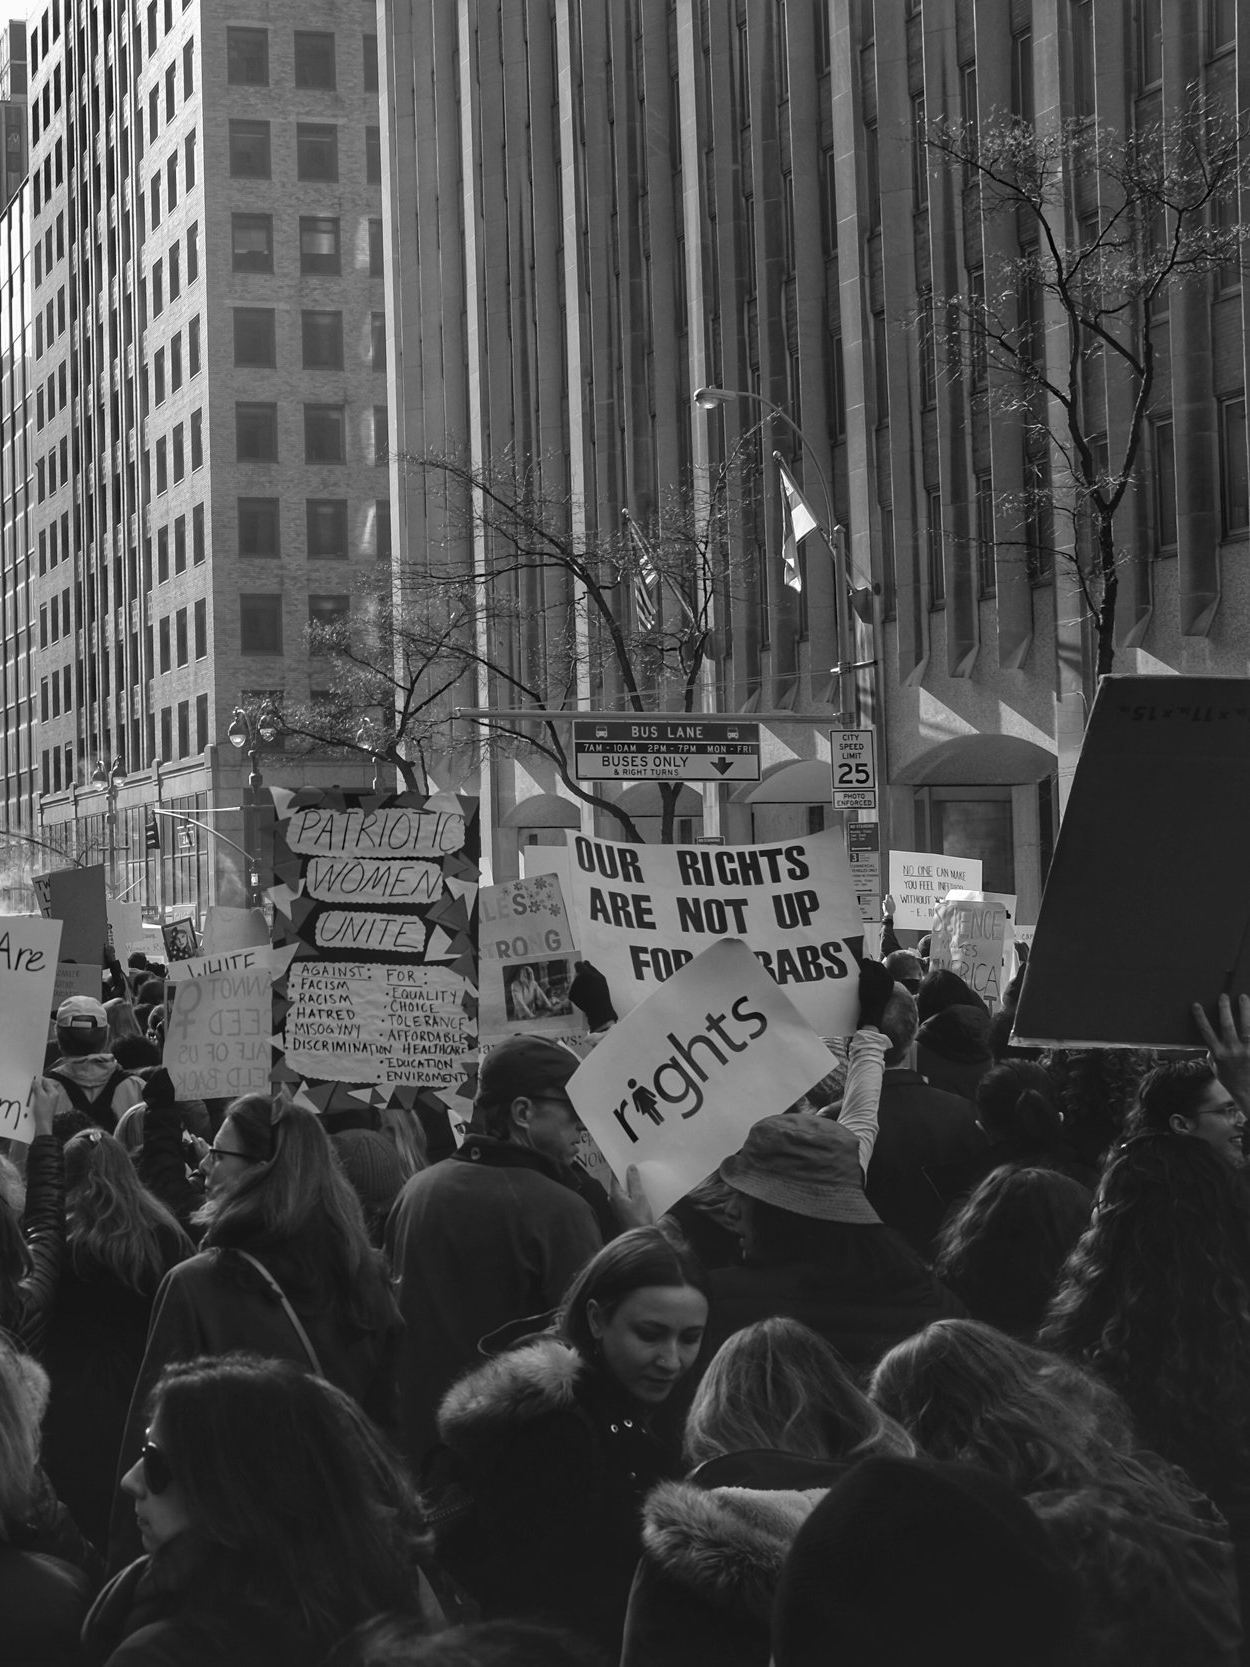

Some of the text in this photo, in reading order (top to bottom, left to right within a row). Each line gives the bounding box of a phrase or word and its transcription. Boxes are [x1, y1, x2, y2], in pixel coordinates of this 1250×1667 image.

[631, 726, 703, 738] BUS LANE
[583, 743, 602, 752] 7AM
[613, 744, 637, 752] 10AM
[647, 744, 667, 753] 2PM
[678, 745, 697, 753] 7PM
[707, 745, 725, 753] MON
[737, 745, 752, 753] FRI
[839, 743, 865, 751] SPEED
[601, 756, 689, 768] BUSES ONLY
[842, 752, 862, 760] LIMIT
[613, 768, 679, 777] & RIGHT TURNS
[837, 762, 870, 785] 25
[297, 810, 462, 851] PATRIOTIC
[574, 835, 810, 886] OUR RIGHTS
[313, 860, 442, 899] WOMEN
[589, 886, 657, 930] ARE
[675, 896, 749, 934] NOT
[772, 889, 821, 930] UP
[320, 911, 419, 949] UNITE
[301, 980, 350, 991] FACISM
[299, 993, 354, 1006] RACISM
[391, 988, 457, 1003] EQUALITY
[296, 1007, 356, 1021] HATRED
[390, 1001, 441, 1015] CHOICE
[387, 1014, 467, 1030] TOLERANCE
[294, 1022, 361, 1039] MISOGYNY
[386, 1030, 468, 1044] AFFORDABLE
[292, 1036, 393, 1056] DISCRIMINATION
[386, 1058, 453, 1070] EDUCATION
